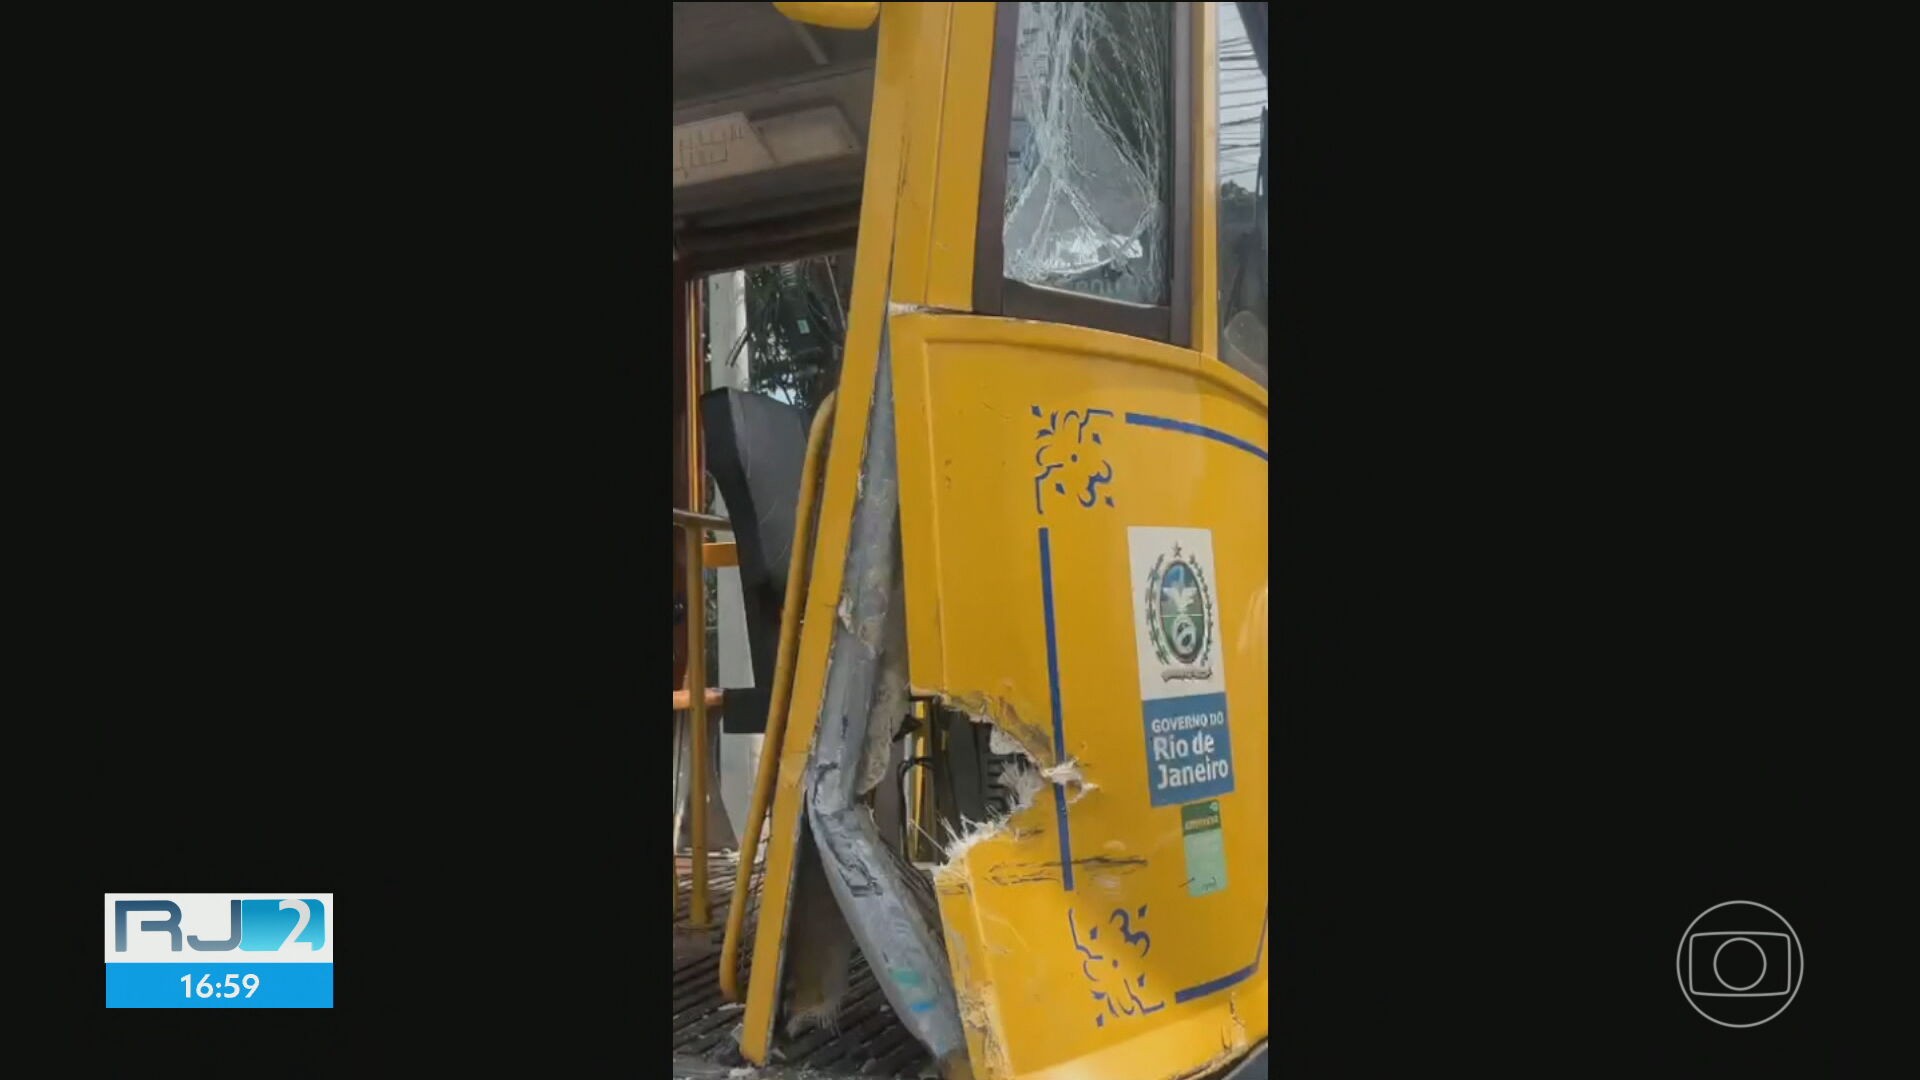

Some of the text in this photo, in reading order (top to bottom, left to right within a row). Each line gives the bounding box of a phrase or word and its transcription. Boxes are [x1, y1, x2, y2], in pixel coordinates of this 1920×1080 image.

[1152, 711, 1224, 733] GOVERNO DO
[1153, 730, 1215, 761] Rio de
[1157, 755, 1229, 790] Janeiro
